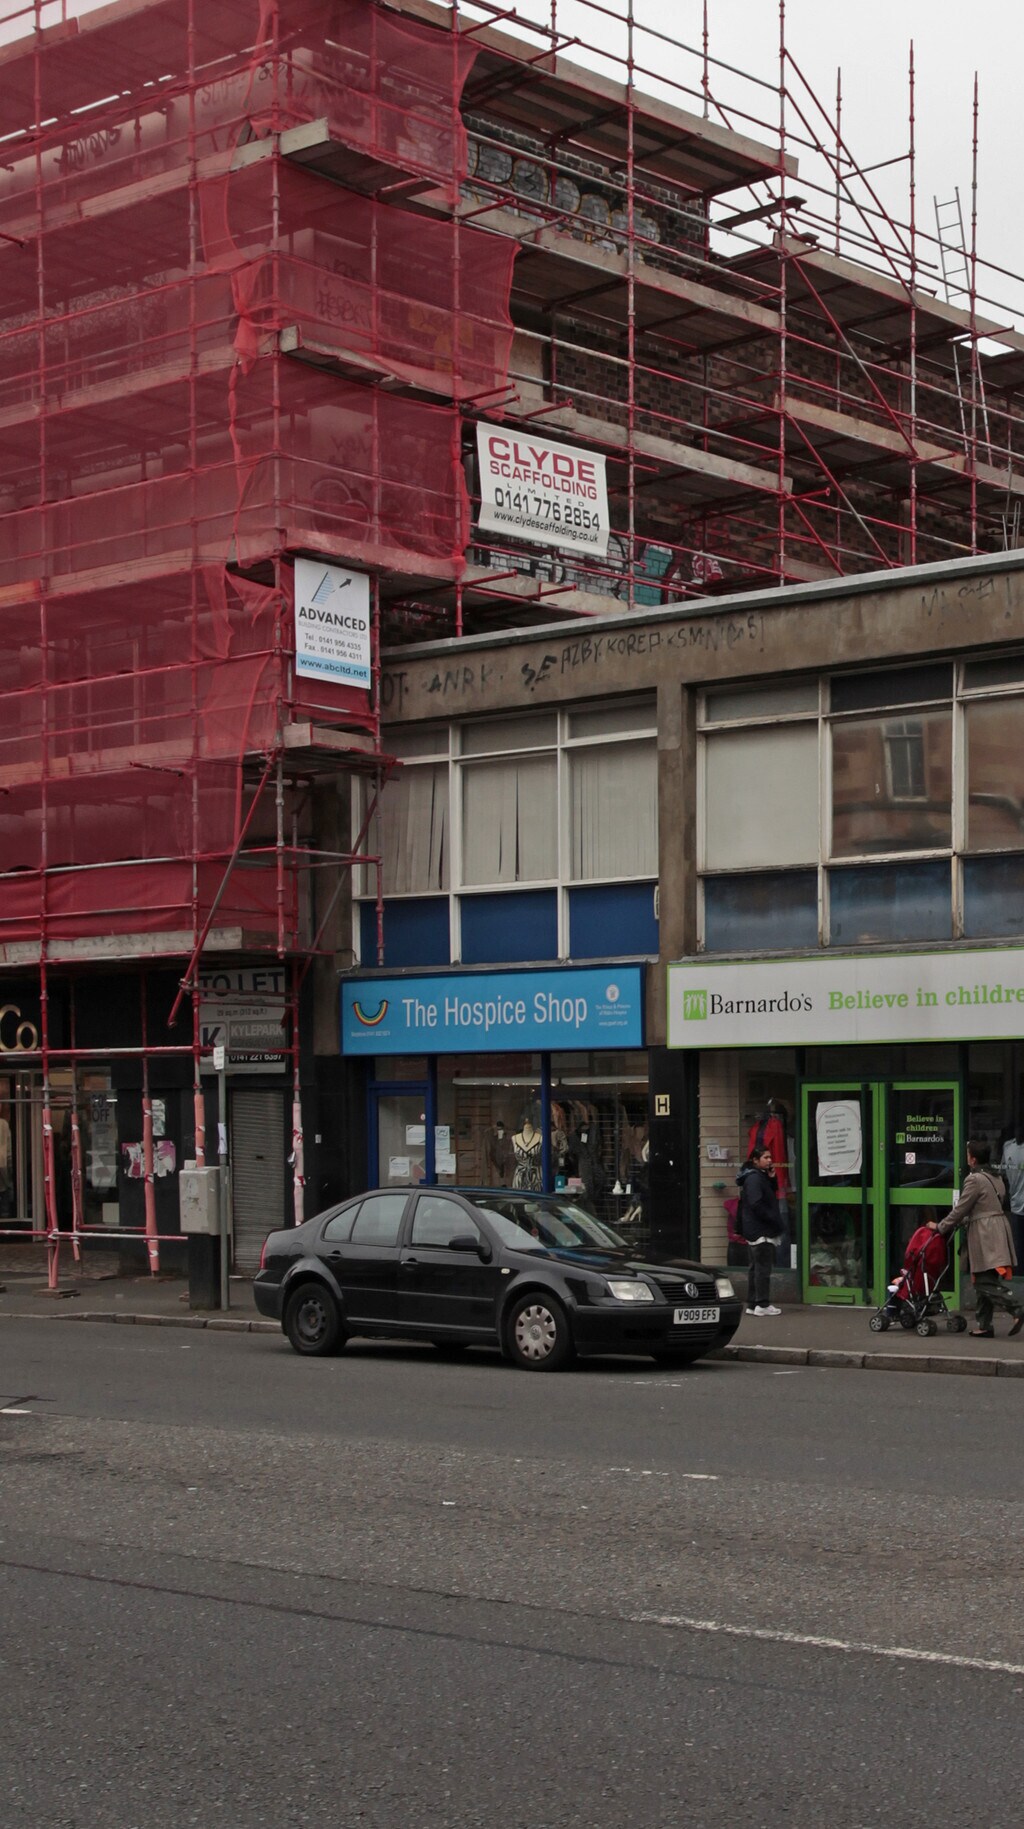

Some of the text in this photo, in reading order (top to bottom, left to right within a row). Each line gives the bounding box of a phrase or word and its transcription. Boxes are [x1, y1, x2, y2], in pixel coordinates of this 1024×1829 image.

[488, 436, 597, 485] CLYDE
[489, 459, 598, 501] SCAFFOLDING
[494, 486, 601, 532] 0141 776 2854
[493, 509, 599, 544] www.clydescaffolding.co.uk
[298, 606, 368, 632] ADVANCED
[299, 658, 368, 679] www.abcltd.net
[200, 971, 284, 997] TO LET
[401, 991, 588, 1032] The Hospice Shop
[709, 990, 814, 1016] Barnardo's
[827, 989, 909, 1011] Believe
[916, 987, 939, 1008] in
[202, 1027, 222, 1058] K
[230, 1023, 284, 1037] KYLEPARK
[92, 1109, 110, 1122] OFF
[656, 1097, 668, 1113] H
[905, 1124, 939, 1132] children
[906, 1114, 944, 1123] Believe in
[905, 1133, 945, 1143] Barnardo's
[677, 1309, 717, 1321] V909 EFS
